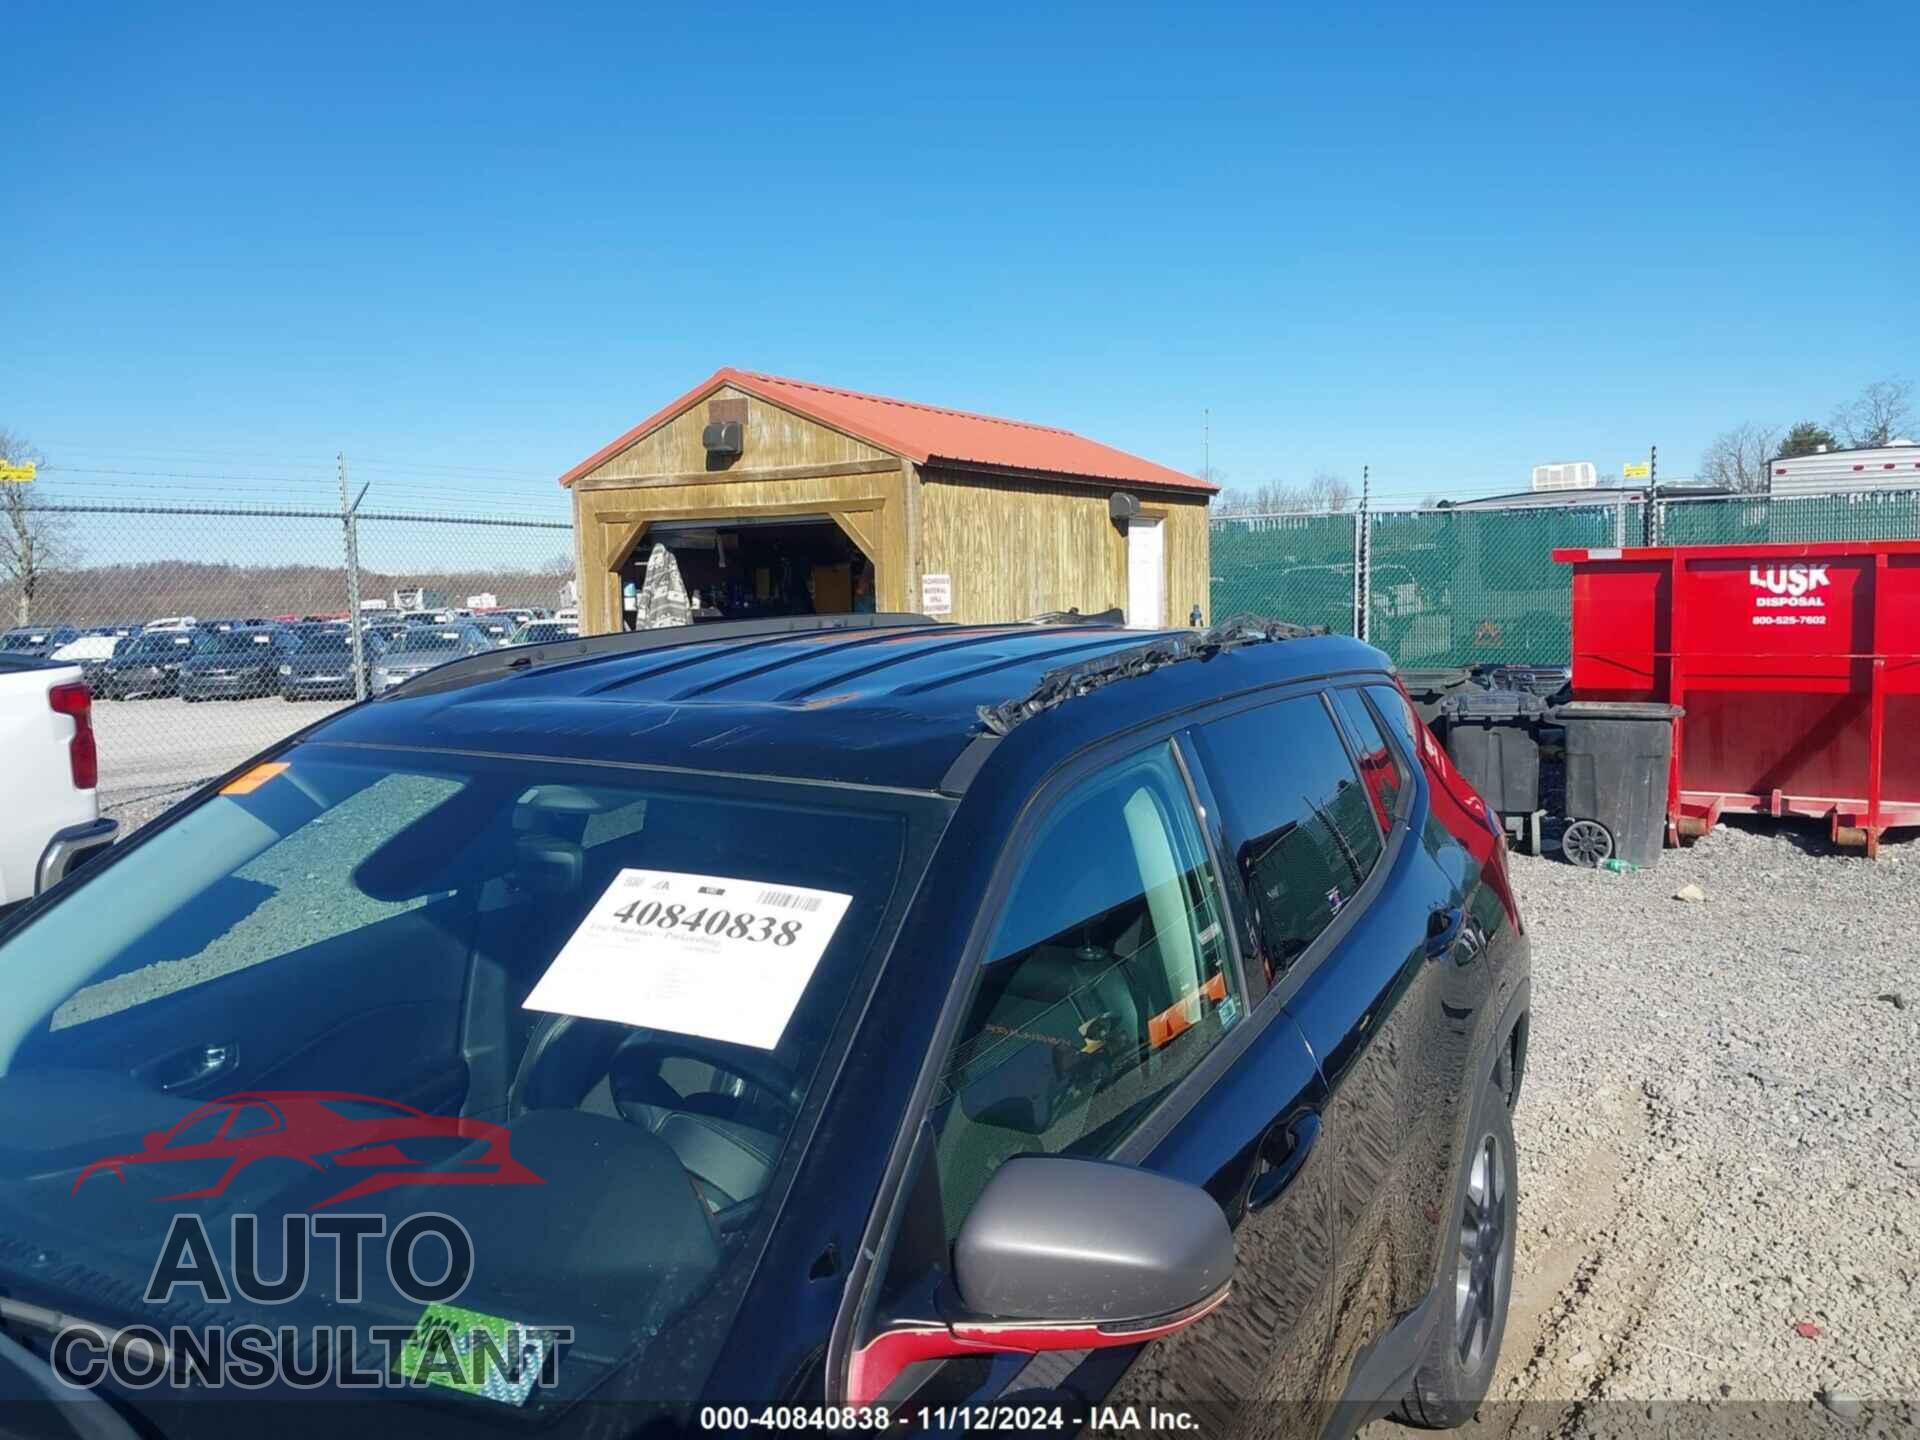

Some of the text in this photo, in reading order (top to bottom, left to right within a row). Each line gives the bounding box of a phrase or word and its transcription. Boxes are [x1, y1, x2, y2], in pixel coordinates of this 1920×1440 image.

[1750, 563, 1831, 597] LUSK
[1756, 597, 1824, 607] DISPOSAL
[613, 899, 803, 947] 40840838
